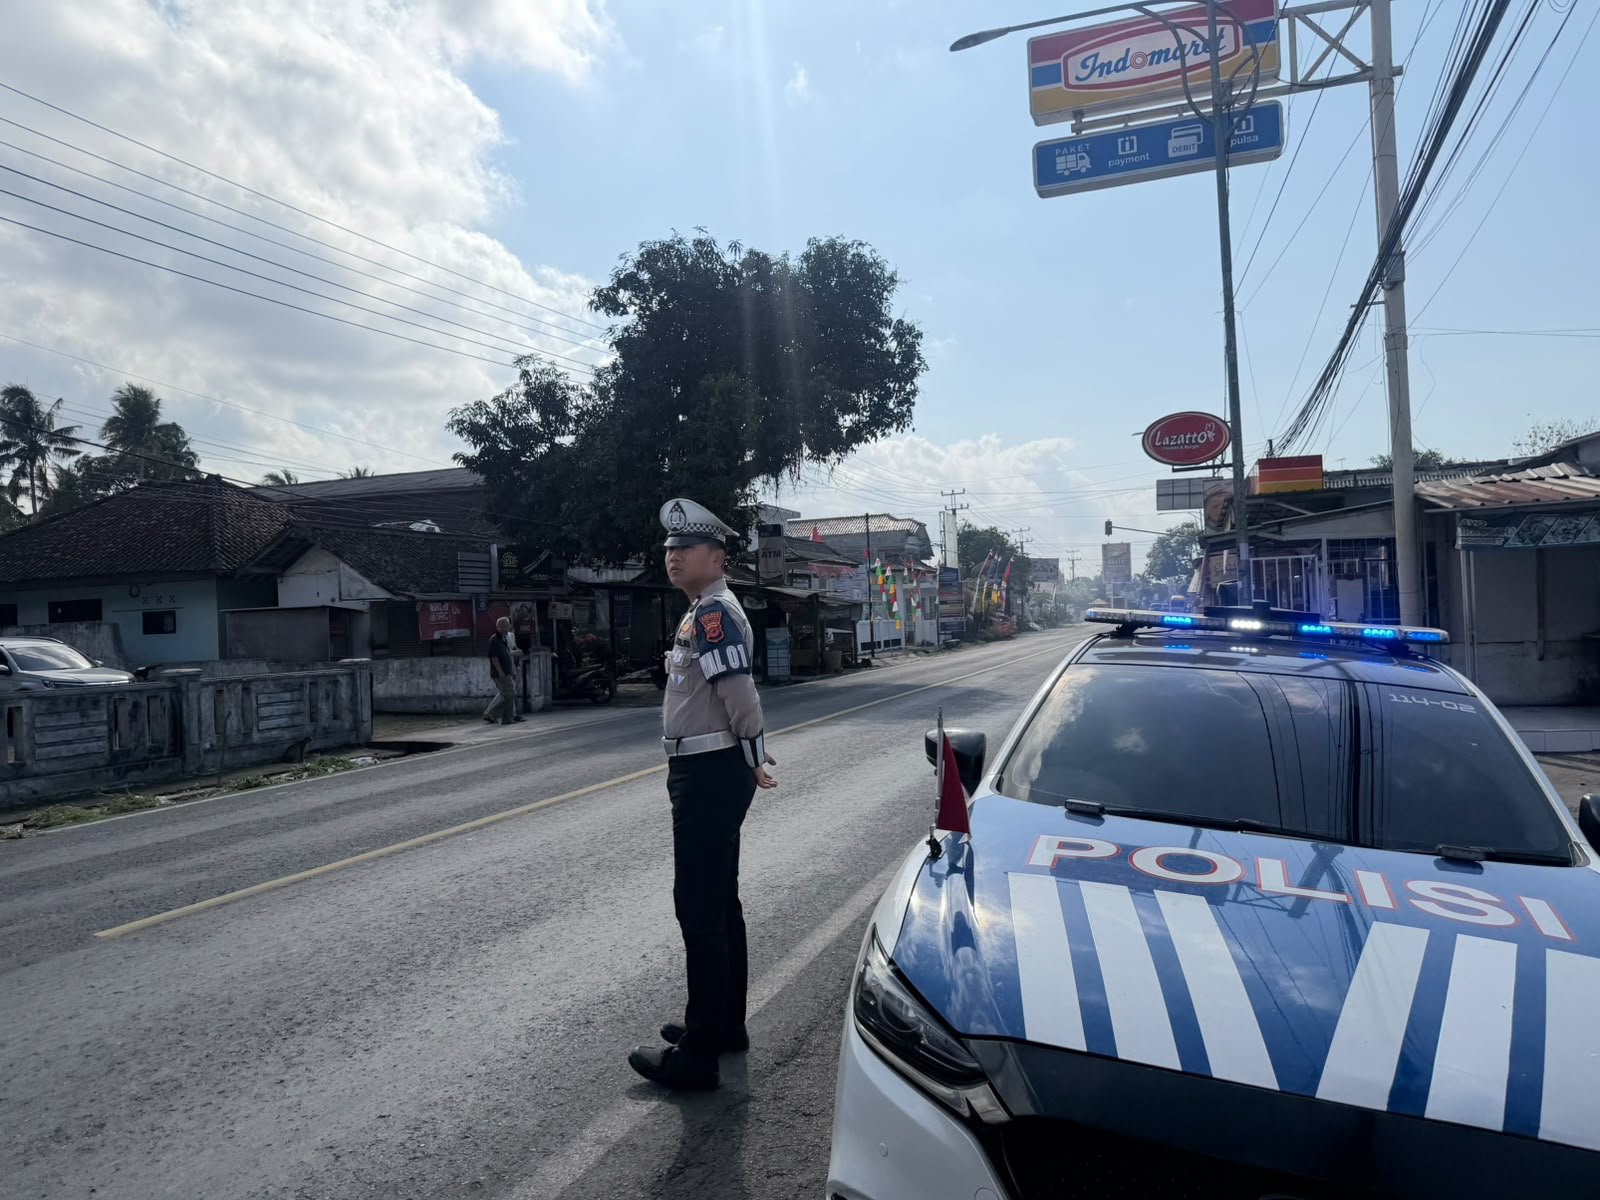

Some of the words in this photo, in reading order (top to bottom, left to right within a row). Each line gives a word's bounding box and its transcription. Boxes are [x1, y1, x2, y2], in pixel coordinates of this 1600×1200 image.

[1056, 143, 1092, 155] PAKET
[1172, 143, 1199, 154] DEBIT
[1231, 134, 1260, 148] pulsa
[1108, 152, 1151, 168] payment
[1155, 430, 1208, 446] Lazatto
[761, 550, 781, 558] ATM
[728, 645, 748, 670] 01
[1388, 693, 1477, 714] 114-02
[1028, 834, 1574, 943] POLISI
